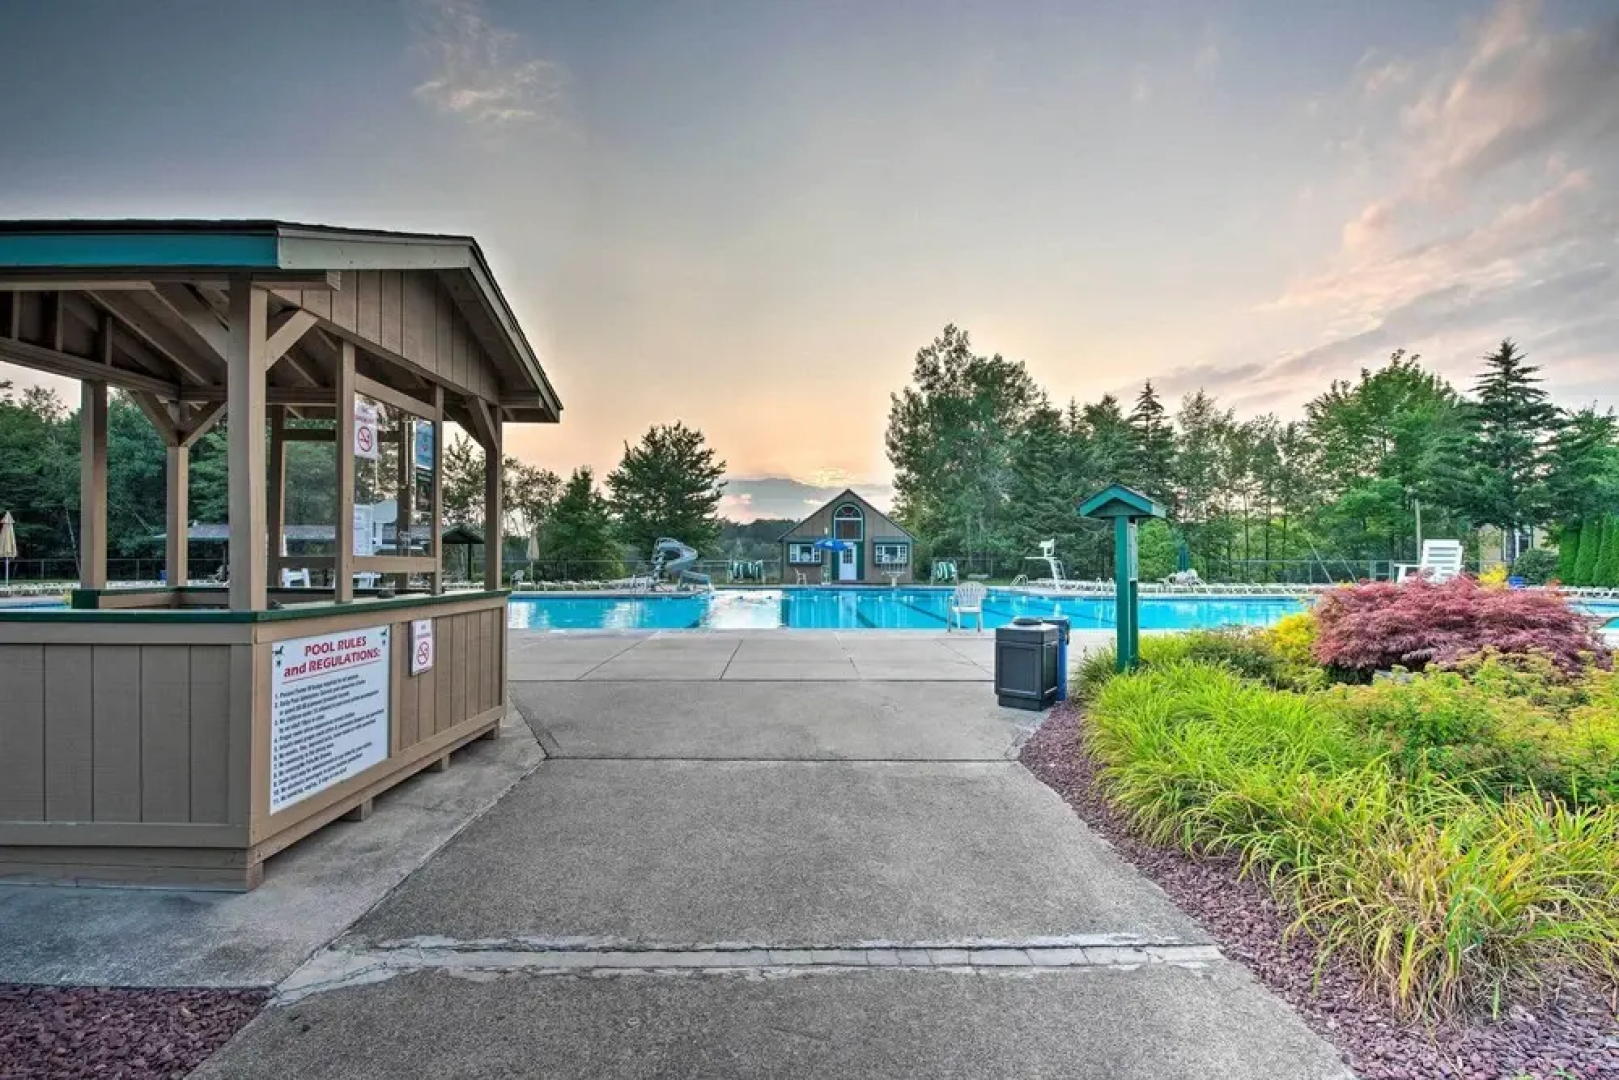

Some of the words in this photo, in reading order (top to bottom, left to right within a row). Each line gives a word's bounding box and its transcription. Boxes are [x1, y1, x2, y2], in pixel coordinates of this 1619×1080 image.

[304, 641, 335, 656] POOL
[337, 636, 367, 651] RULES
[284, 662, 306, 677] and
